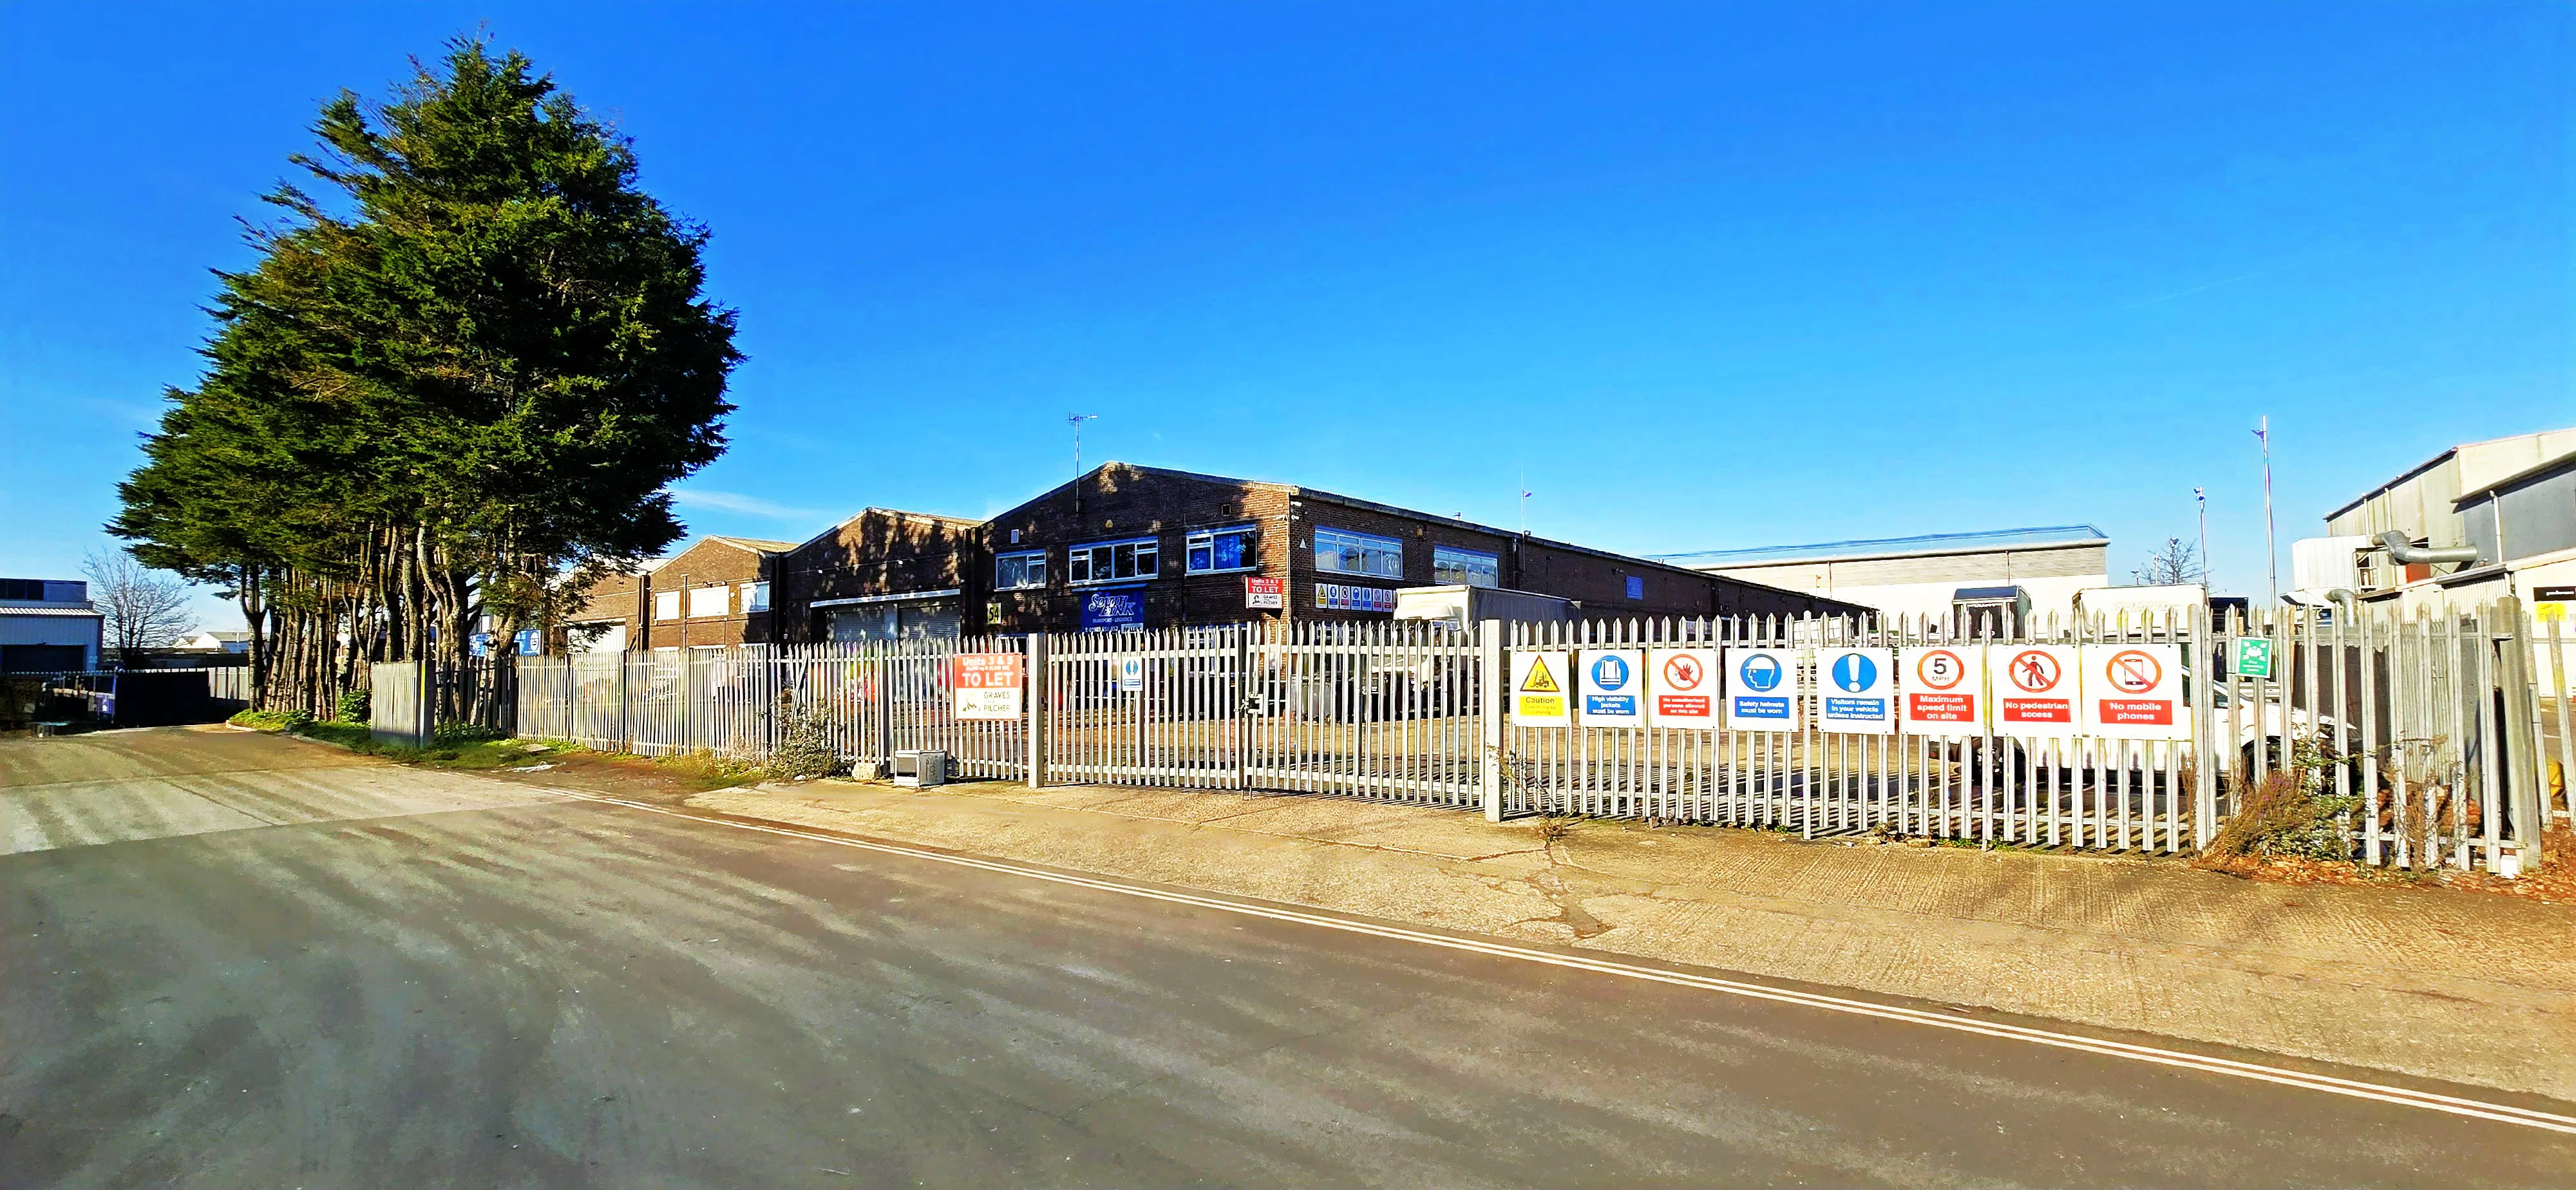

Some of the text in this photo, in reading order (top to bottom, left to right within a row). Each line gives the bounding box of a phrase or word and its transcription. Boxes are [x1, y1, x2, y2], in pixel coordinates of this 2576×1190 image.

[989, 607, 999, 621] 54
[963, 656, 1014, 666] Units 3 & 5
[1934, 658, 1947, 675] 5
[962, 672, 1014, 686] TO LET
[1917, 704, 1945, 712] speed
[2117, 712, 2155, 721] phones
